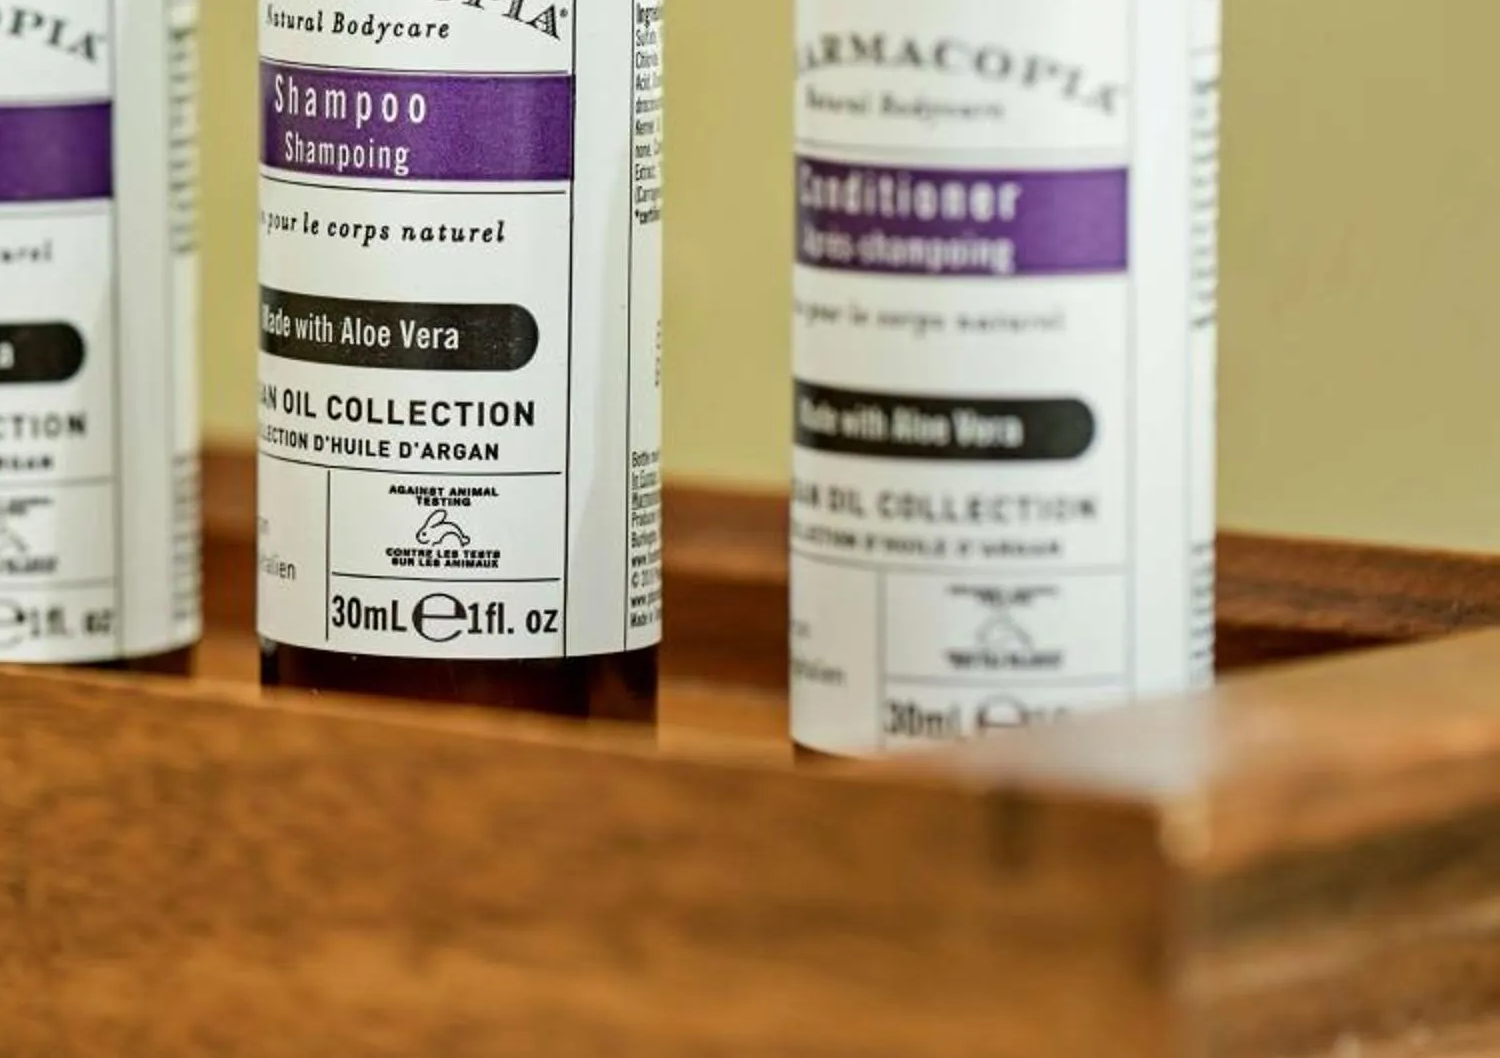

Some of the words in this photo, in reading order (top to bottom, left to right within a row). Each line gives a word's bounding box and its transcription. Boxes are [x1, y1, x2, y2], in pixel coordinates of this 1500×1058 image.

[332, 11, 450, 44] Bodycare
[796, 33, 1120, 117] ARMACOPIA
[274, 73, 427, 130] Shampoo
[284, 130, 411, 177] Shampoing
[799, 162, 1023, 223] Conditioner
[303, 210, 320, 235] le
[327, 221, 390, 247] corps
[401, 219, 506, 244] naturel
[295, 312, 333, 343] with
[341, 315, 392, 348] Aloe
[399, 318, 460, 351] Vera
[283, 388, 317, 418] OIL
[326, 394, 536, 428] COLLECTION
[890, 406, 951, 445] Aloe
[954, 409, 1025, 448] Vera
[313, 433, 391, 458] D'HUILE
[399, 441, 500, 461] D'ARGAN
[389, 484, 446, 496] AGAINST
[449, 486, 500, 497] ANIMAL
[416, 496, 472, 507] TESTING
[877, 490, 1098, 525] COLLECTION
[385, 547, 434, 558] CONTRE
[444, 559, 499, 569] ANIMAUX
[331, 594, 408, 632] 30mL
[526, 609, 559, 634] oz
